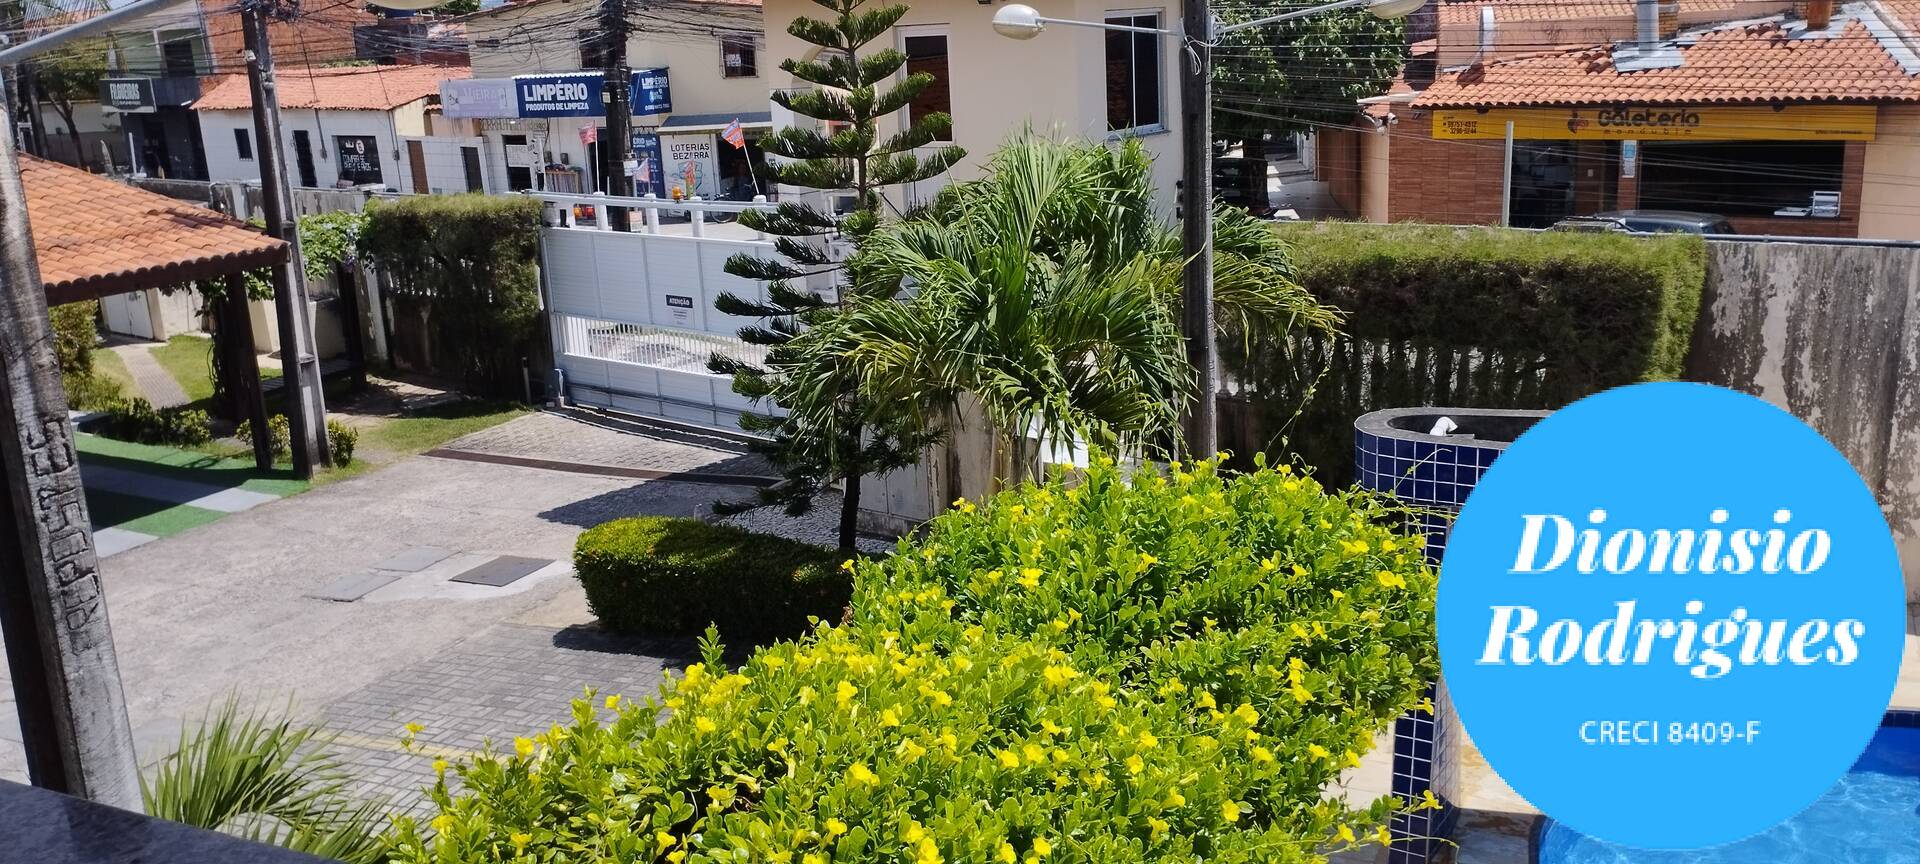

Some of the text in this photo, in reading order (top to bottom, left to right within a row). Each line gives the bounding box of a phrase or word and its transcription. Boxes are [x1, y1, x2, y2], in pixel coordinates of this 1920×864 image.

[524, 79, 588, 102] LIMPÉRIO
[525, 101, 589, 112] PRODUTOS DE LIMPEZA
[670, 143, 710, 152] LOTERIAS
[669, 297, 690, 306] ATENÇÃO
